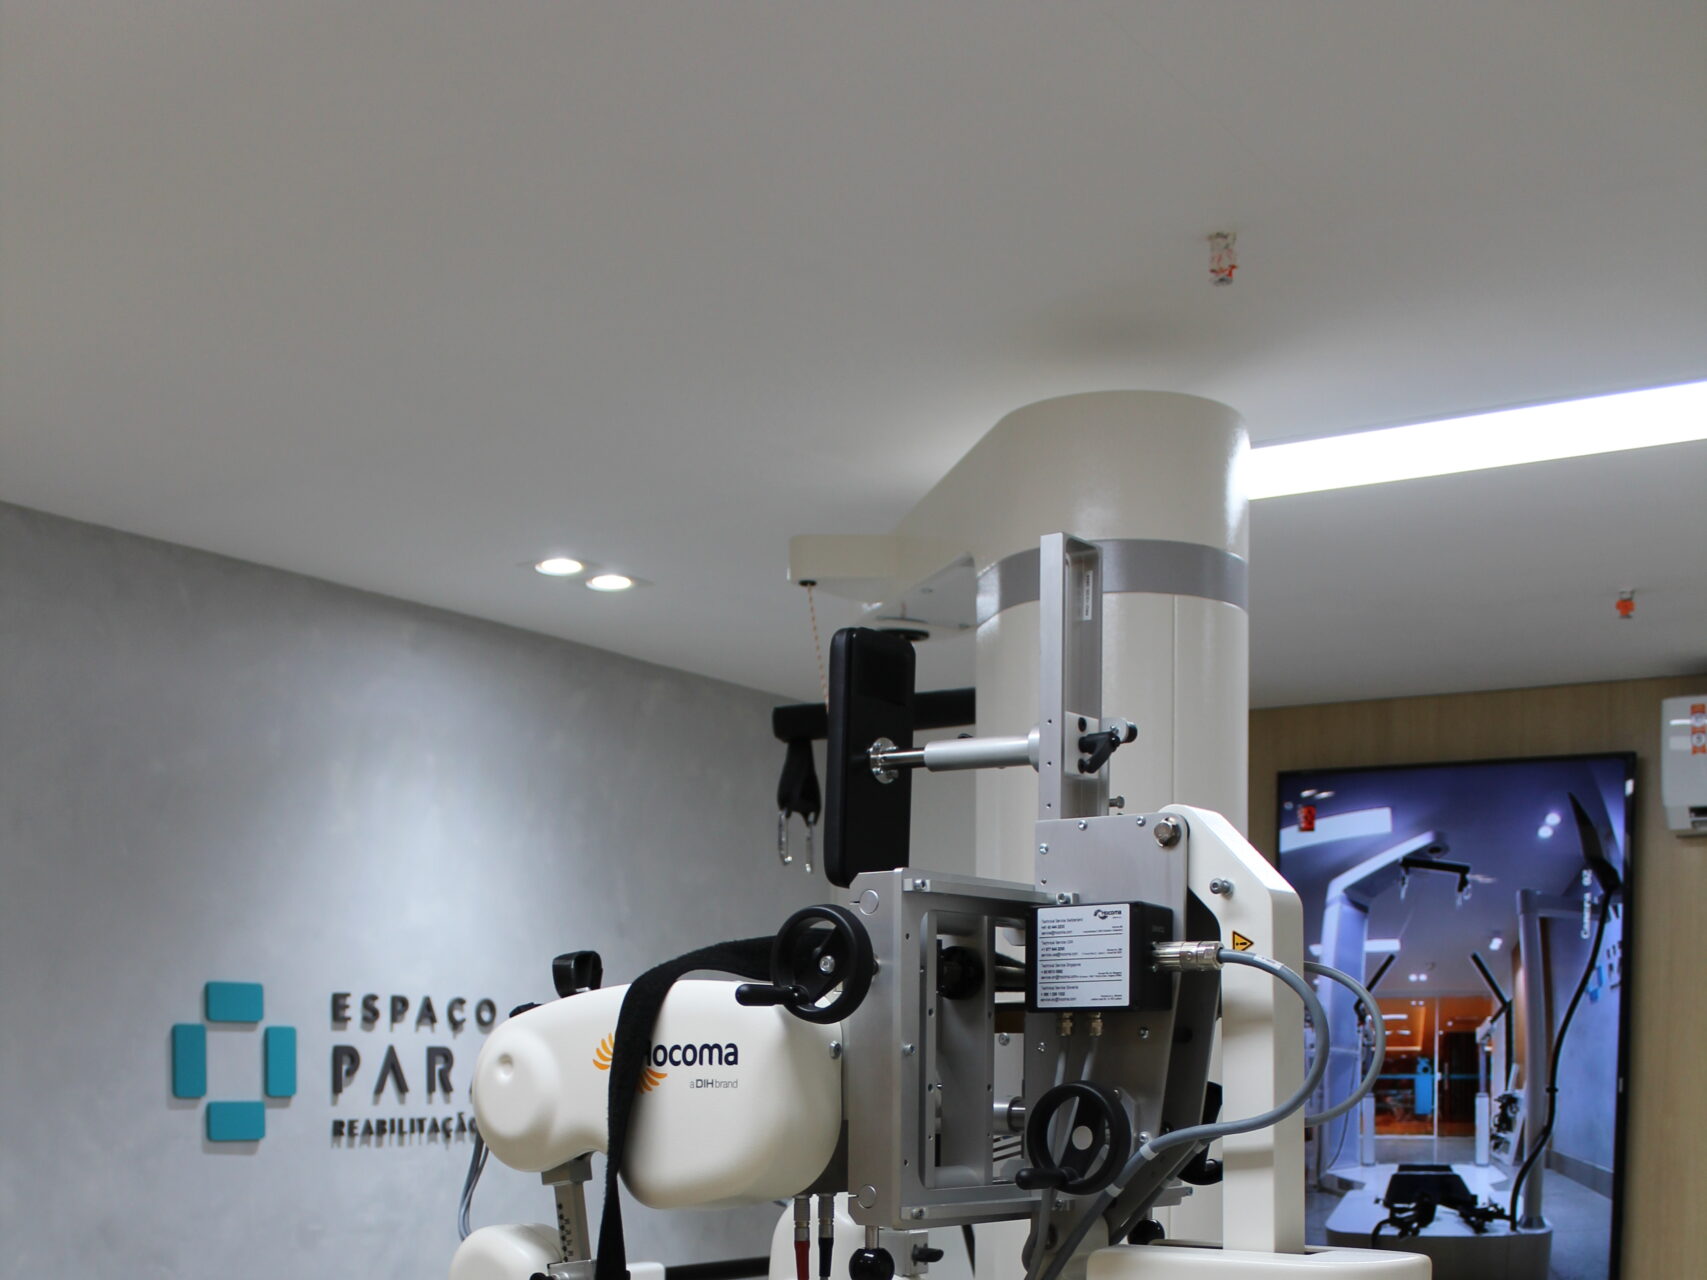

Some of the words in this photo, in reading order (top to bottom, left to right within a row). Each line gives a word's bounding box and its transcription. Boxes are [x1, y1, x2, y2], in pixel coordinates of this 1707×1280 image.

[331, 992, 497, 1030] ESPAÇO
[332, 1045, 475, 1096] PAR
[695, 1079, 714, 1089] DIH
[715, 1079, 739, 1089] brand
